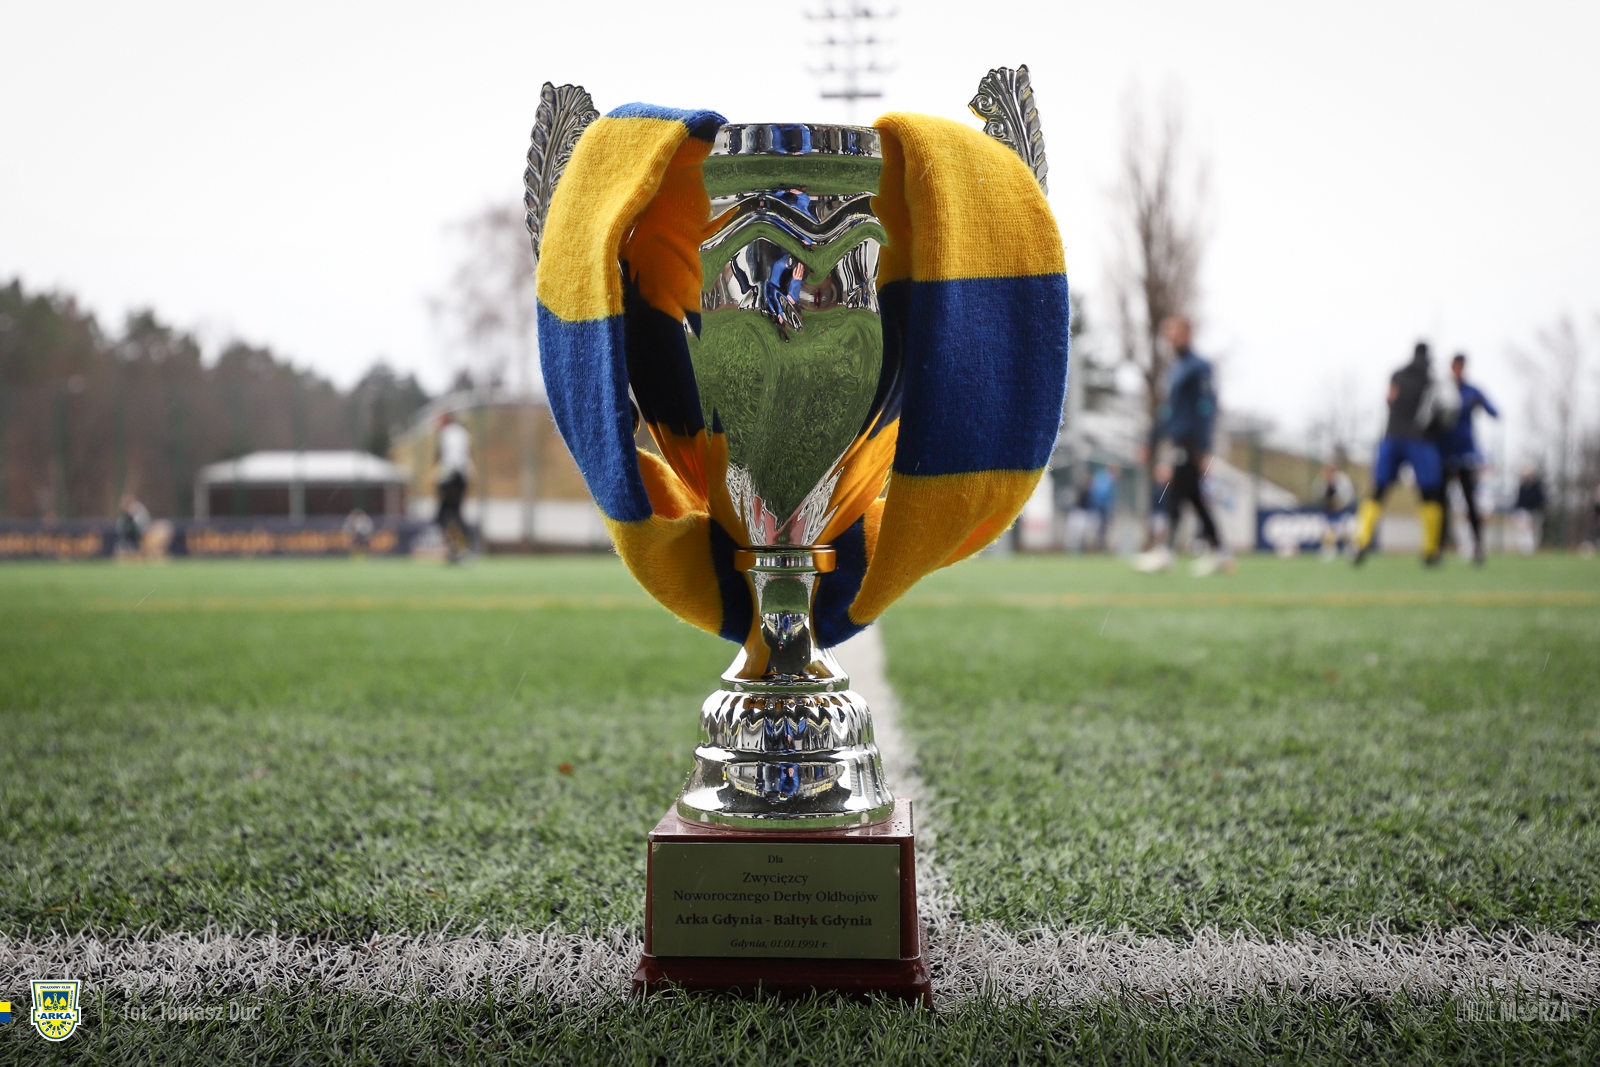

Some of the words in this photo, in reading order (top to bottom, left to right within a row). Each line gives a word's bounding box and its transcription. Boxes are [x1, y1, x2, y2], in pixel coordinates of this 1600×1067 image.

[768, 855, 783, 864] Dla
[742, 872, 809, 886] Zwycięzcy
[673, 890, 770, 904] Noworocznego
[774, 891, 813, 904] Derby
[816, 891, 879, 906] Oldbojów
[675, 914, 709, 926] Arka
[712, 914, 763, 928] Gdynia
[773, 914, 819, 928] Bałtyk
[822, 914, 873, 929] Gdynia
[730, 938, 768, 950] Gdynia,
[770, 939, 819, 949] 01.01.1991
[822, 941, 828, 949] r.
